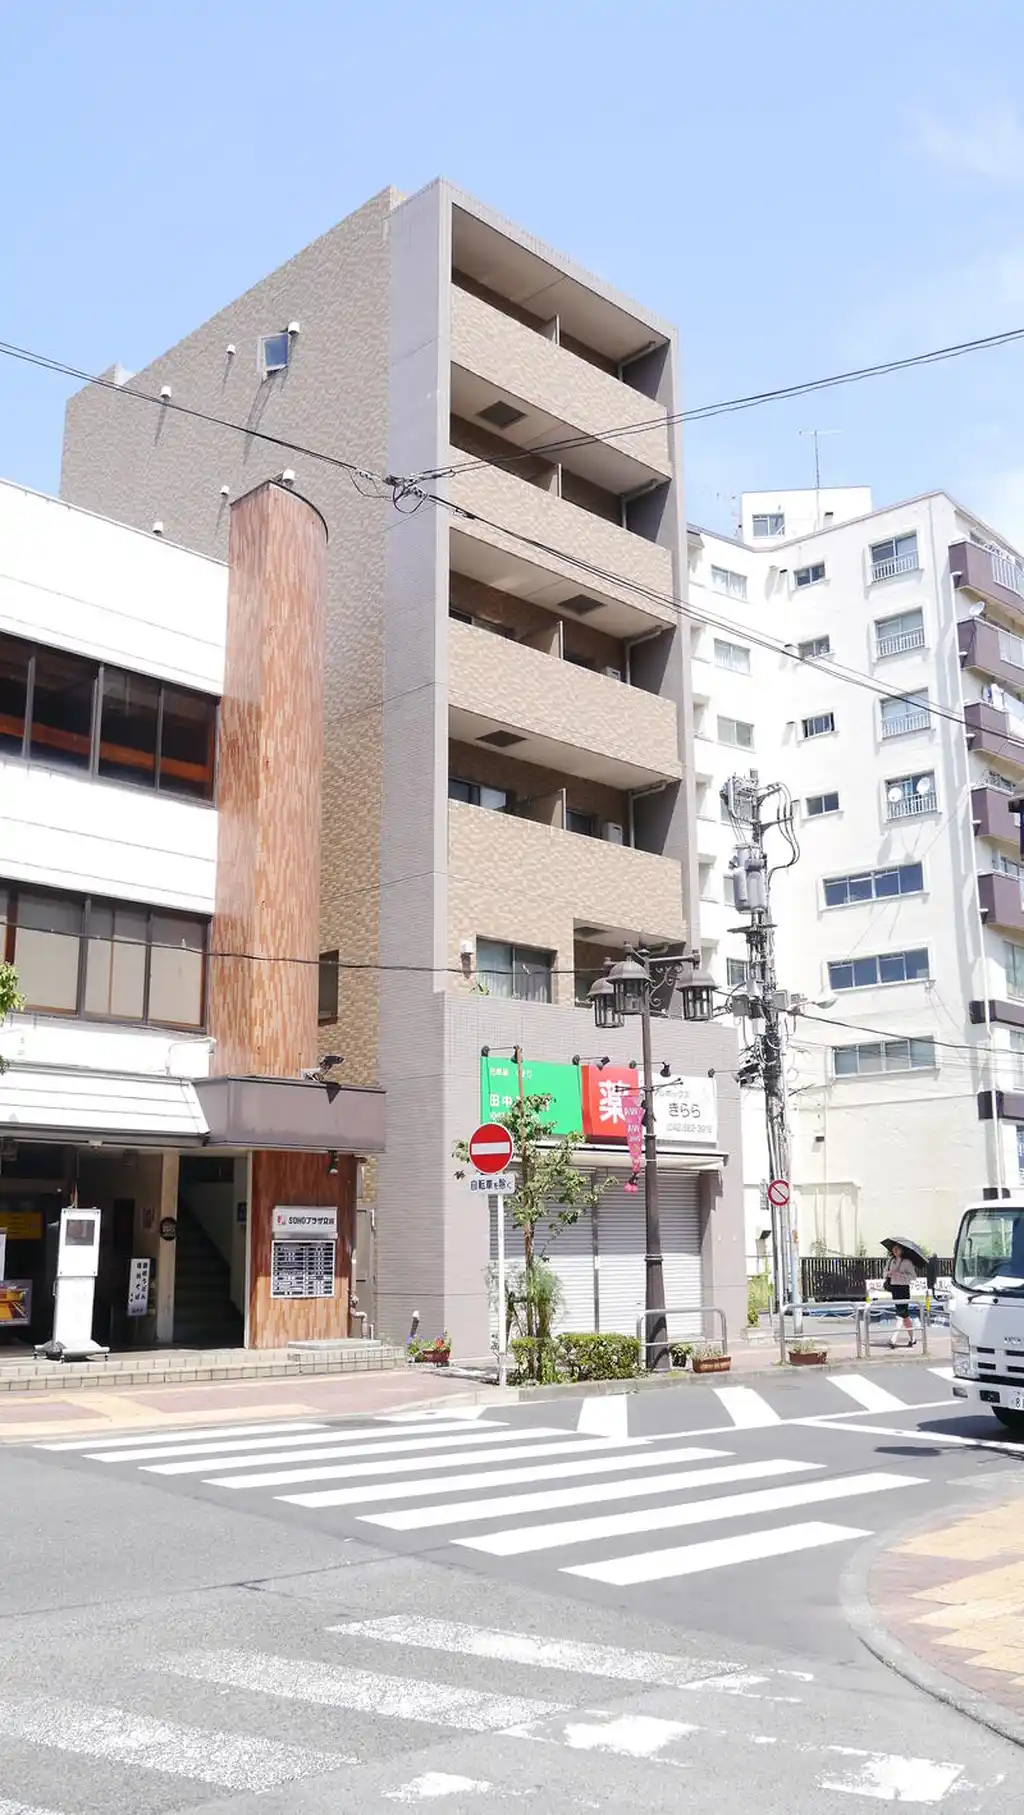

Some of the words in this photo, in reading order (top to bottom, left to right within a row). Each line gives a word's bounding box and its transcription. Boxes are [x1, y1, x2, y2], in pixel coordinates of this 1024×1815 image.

[598, 1079, 632, 1125] 薬
[668, 1102, 702, 1119] きらら
[470, 1178, 512, 1191] 自転車を除く
